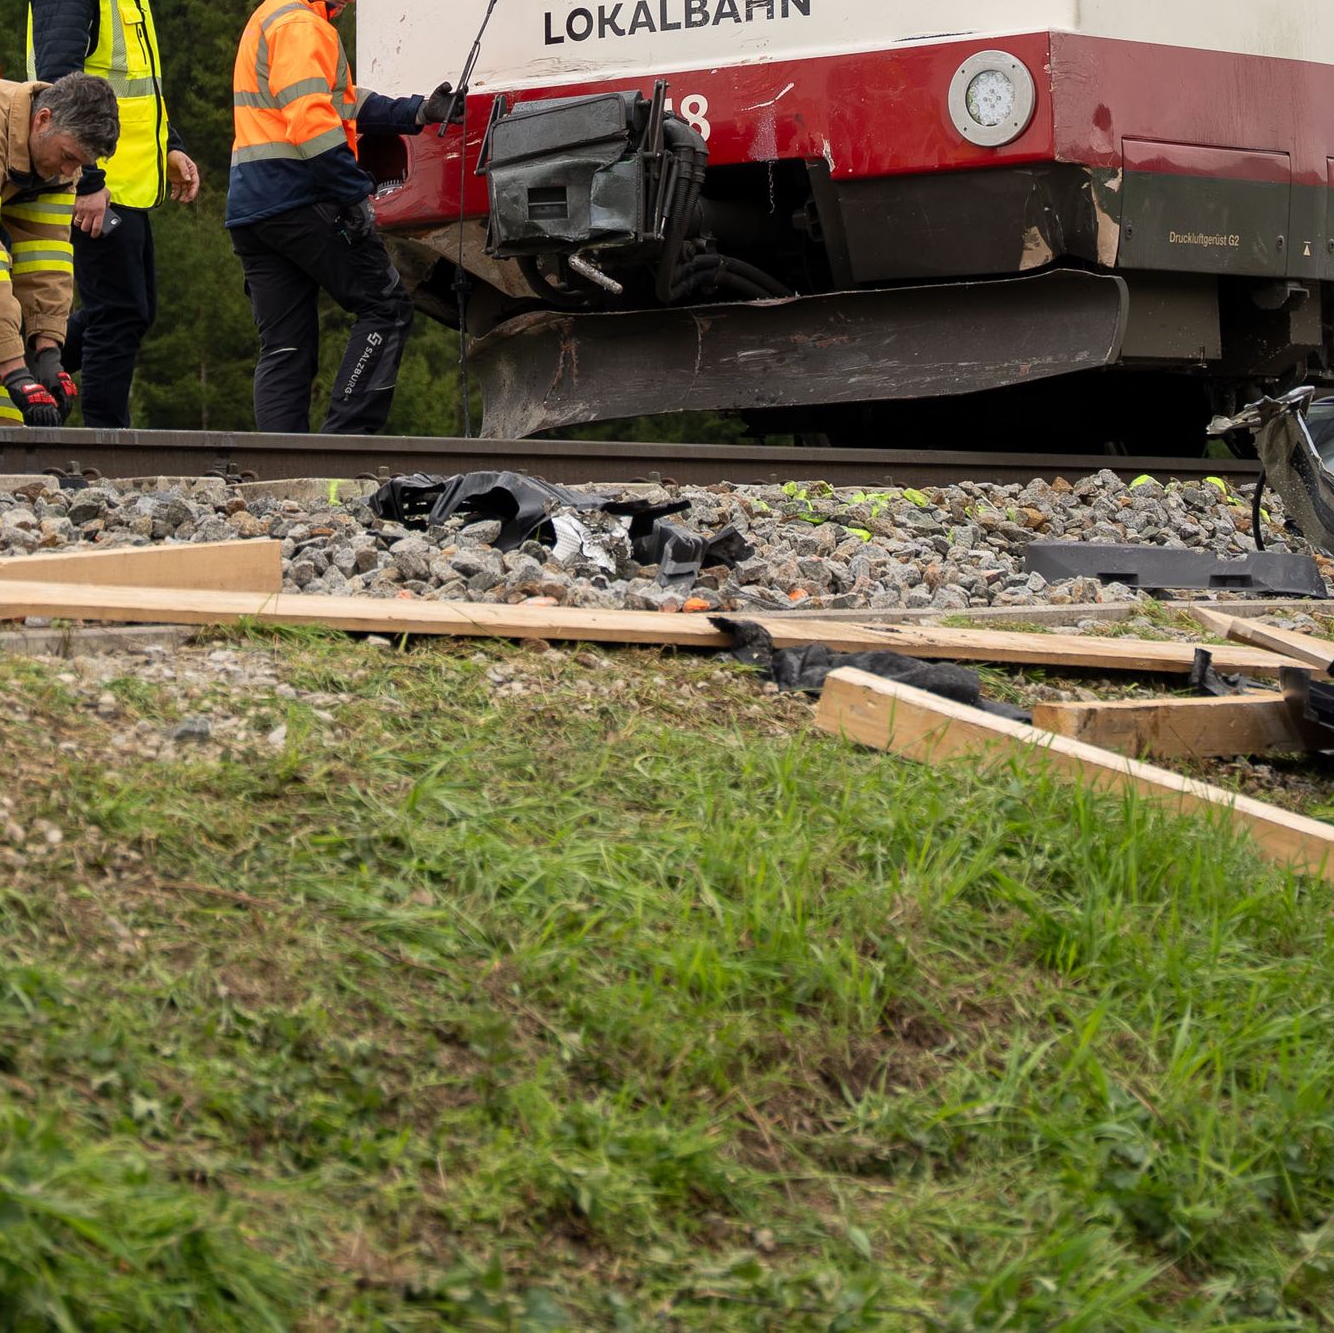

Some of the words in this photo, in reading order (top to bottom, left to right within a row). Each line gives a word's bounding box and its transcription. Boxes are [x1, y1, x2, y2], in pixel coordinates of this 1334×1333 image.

[663, 93, 711, 142] 8
[1169, 231, 1227, 247] Druckluftgerüst
[1228, 234, 1240, 246] G2
[344, 346, 373, 394] SALZBURG
